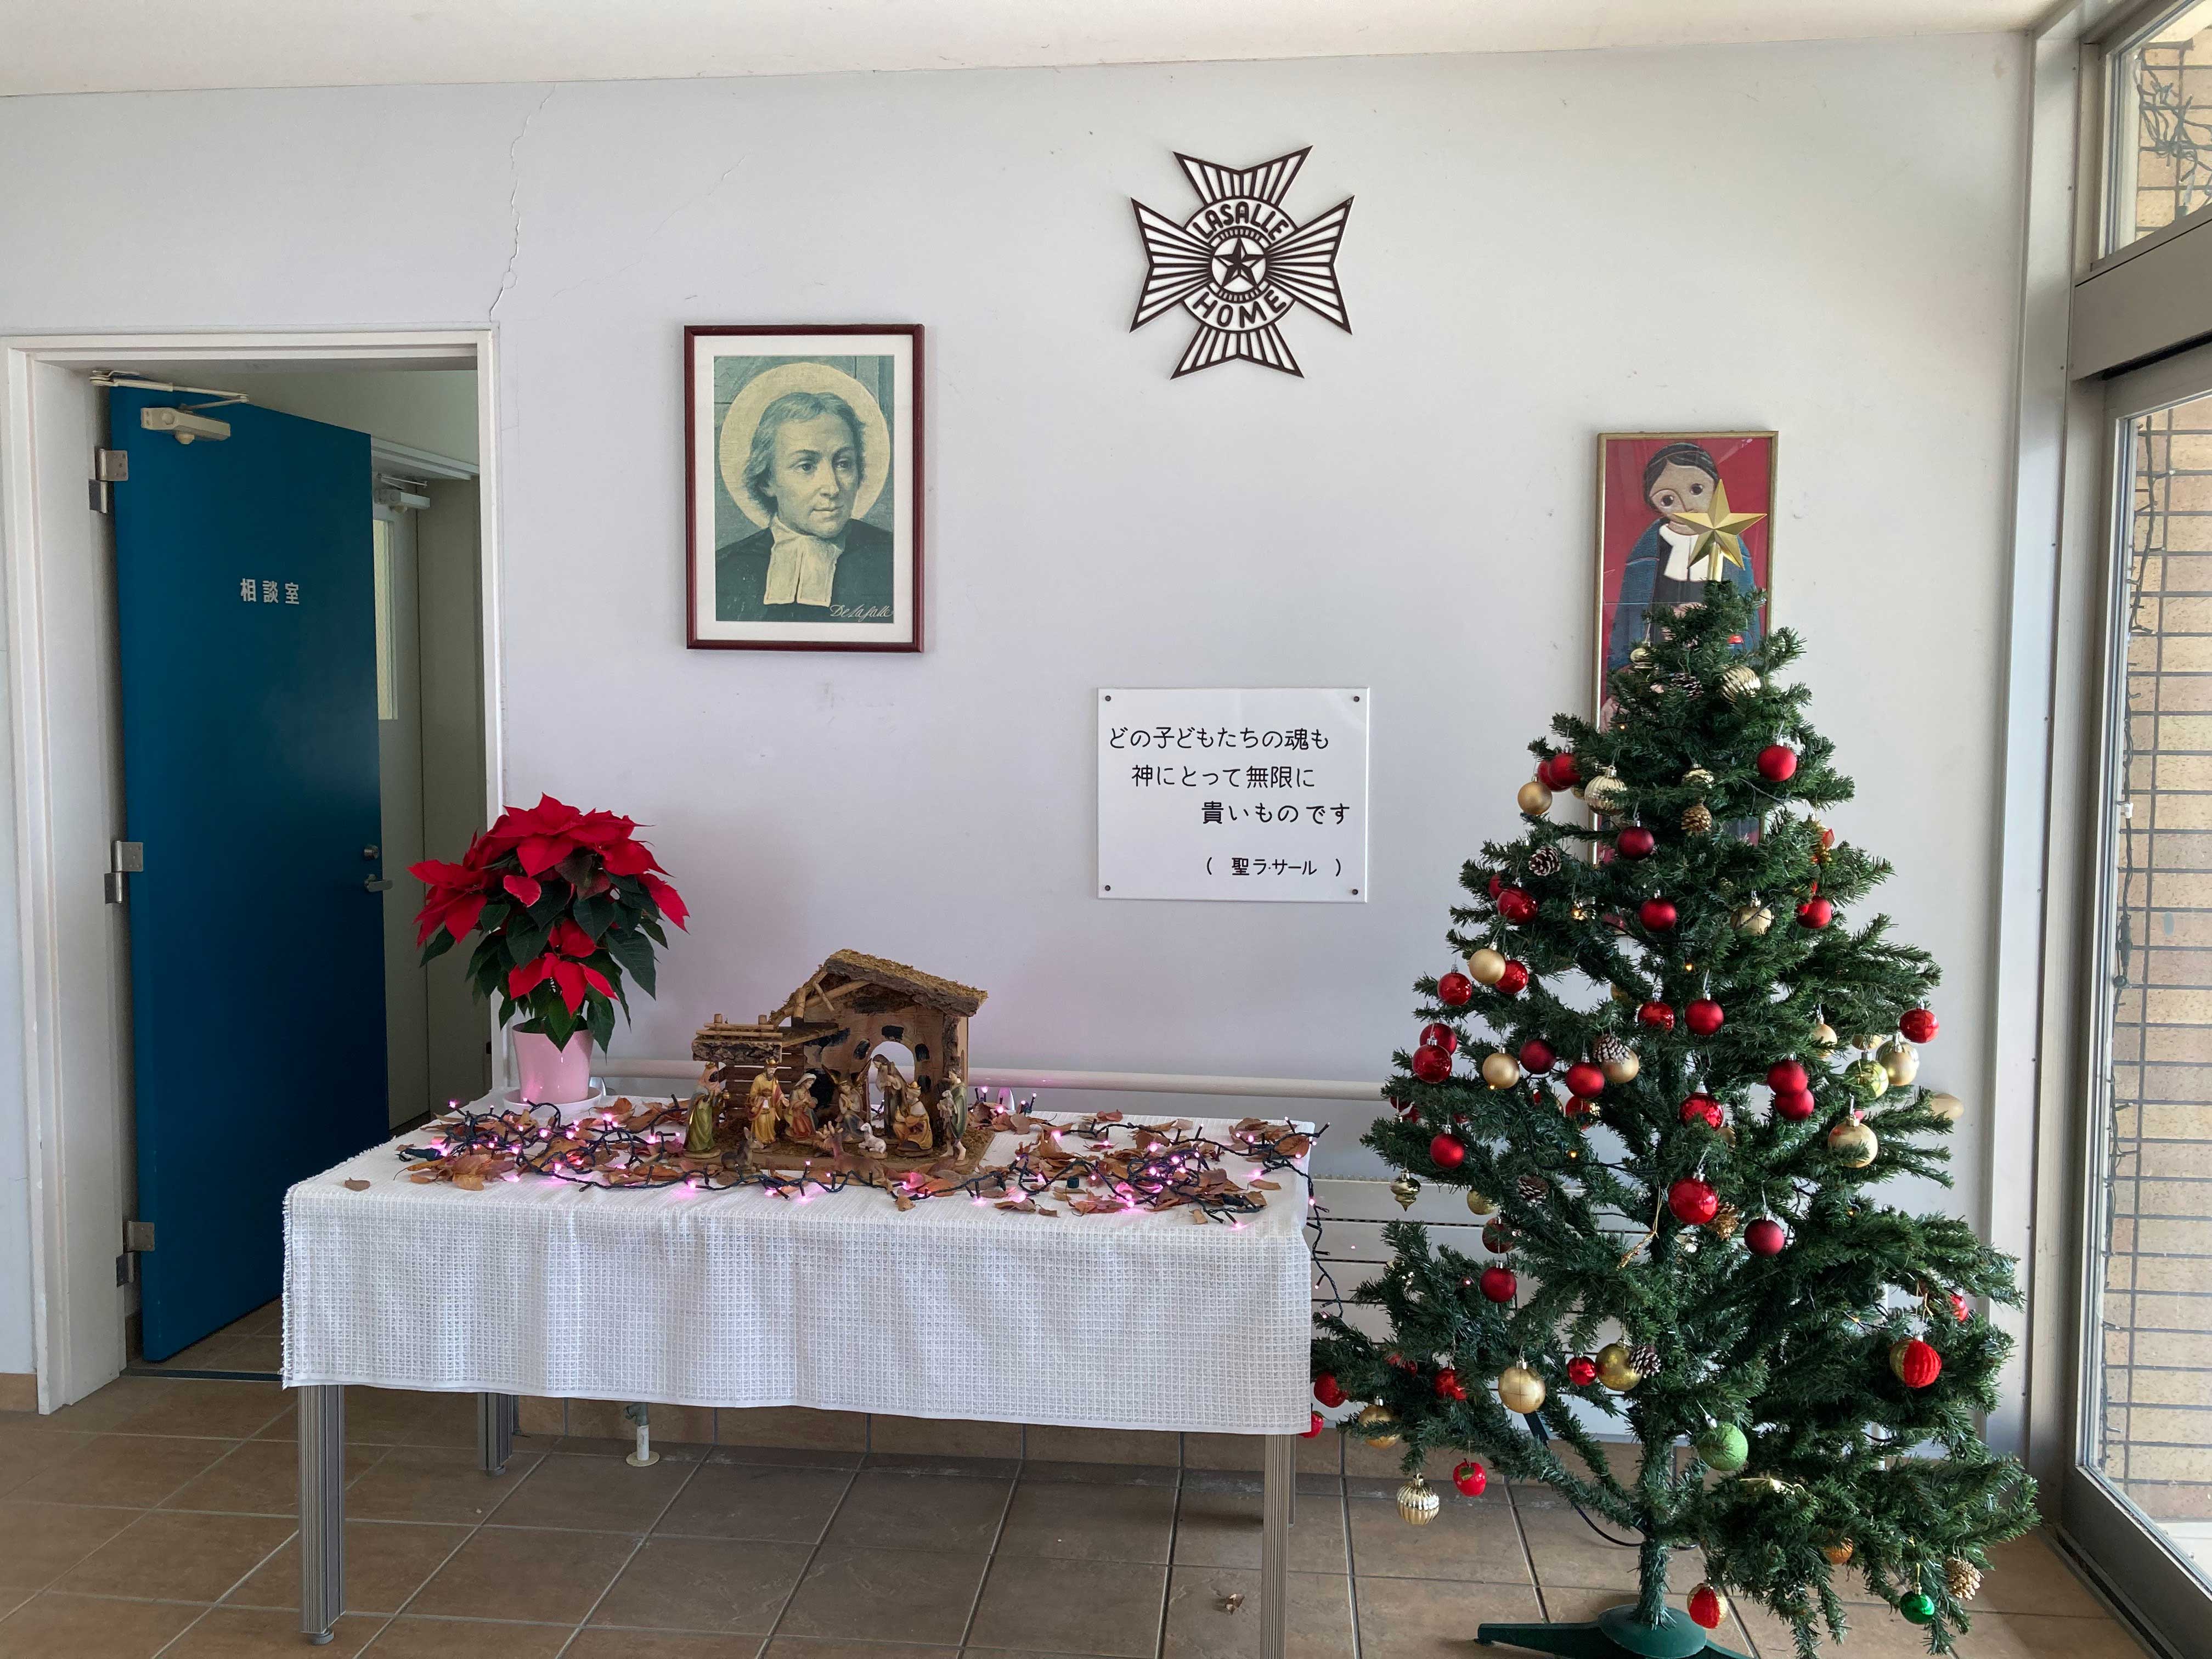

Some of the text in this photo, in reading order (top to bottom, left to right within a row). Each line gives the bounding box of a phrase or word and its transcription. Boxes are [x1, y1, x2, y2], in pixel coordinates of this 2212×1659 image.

[1192, 201, 1290, 240] LASALLE
[1193, 290, 1286, 329] HOME
[240, 578, 300, 605] 相談室
[1109, 726, 1329, 751] どの子どもたちの魂も
[1131, 764, 1315, 789] 神にとって無限に
[1201, 800, 1350, 825] 貴いものです
